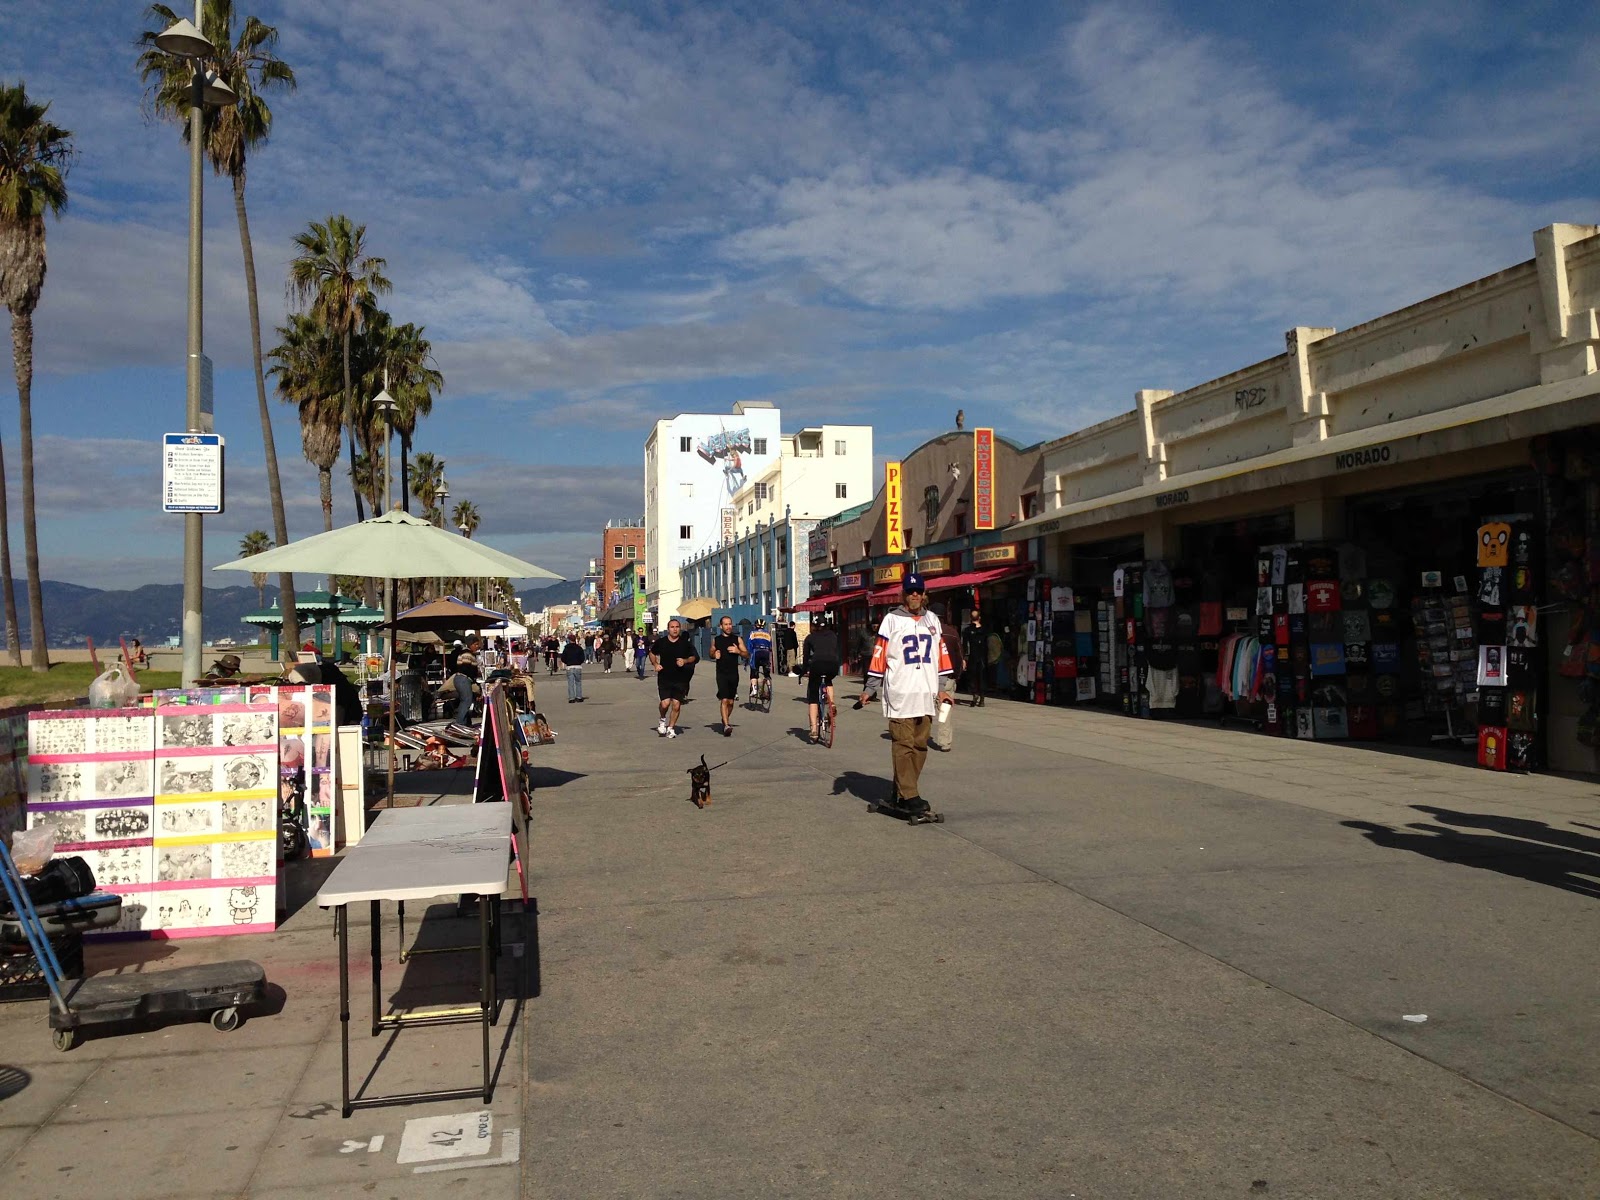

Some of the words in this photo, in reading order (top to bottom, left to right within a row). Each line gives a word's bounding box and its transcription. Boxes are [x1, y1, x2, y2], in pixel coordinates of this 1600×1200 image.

[1335, 446, 1391, 470] MORADO
[978, 435, 991, 522] INDIGENOUS
[889, 468, 899, 549] PIZZA
[1156, 490, 1189, 507] MORADO
[902, 633, 932, 665] 27
[428, 1128, 464, 1147] 42
